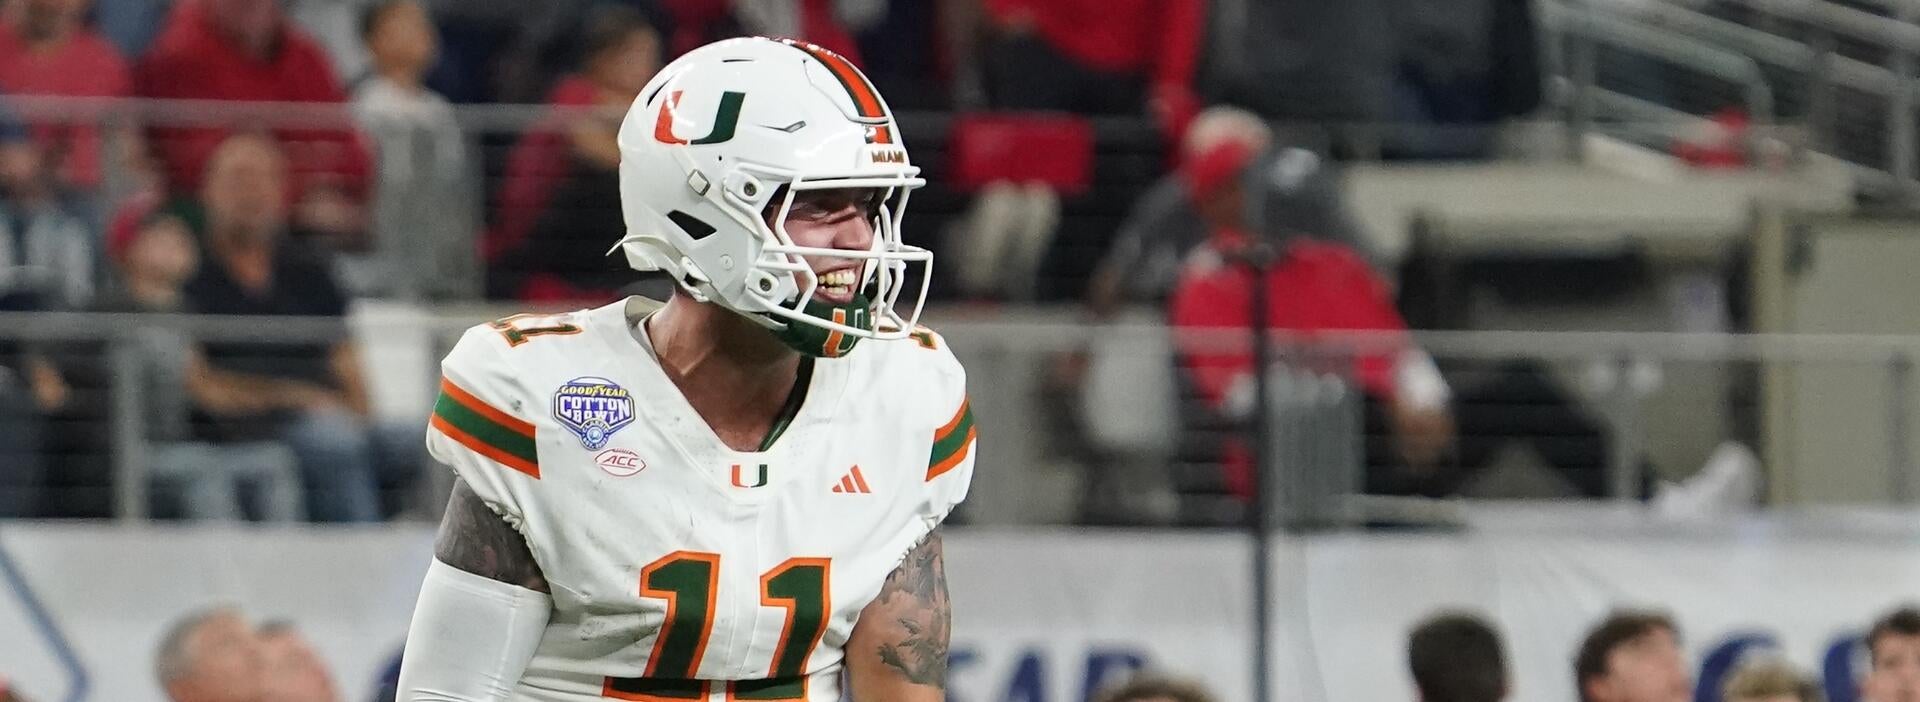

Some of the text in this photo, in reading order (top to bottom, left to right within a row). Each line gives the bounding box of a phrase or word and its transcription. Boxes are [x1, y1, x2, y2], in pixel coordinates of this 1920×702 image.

[655, 90, 746, 145] U
[871, 150, 904, 163] MIAMI
[561, 384, 627, 397] GOODYEAR
[560, 396, 631, 420] COTTON
[572, 409, 619, 424] BOWL
[601, 455, 639, 468] ACC
[731, 464, 768, 488] U
[600, 550, 832, 702] 11
